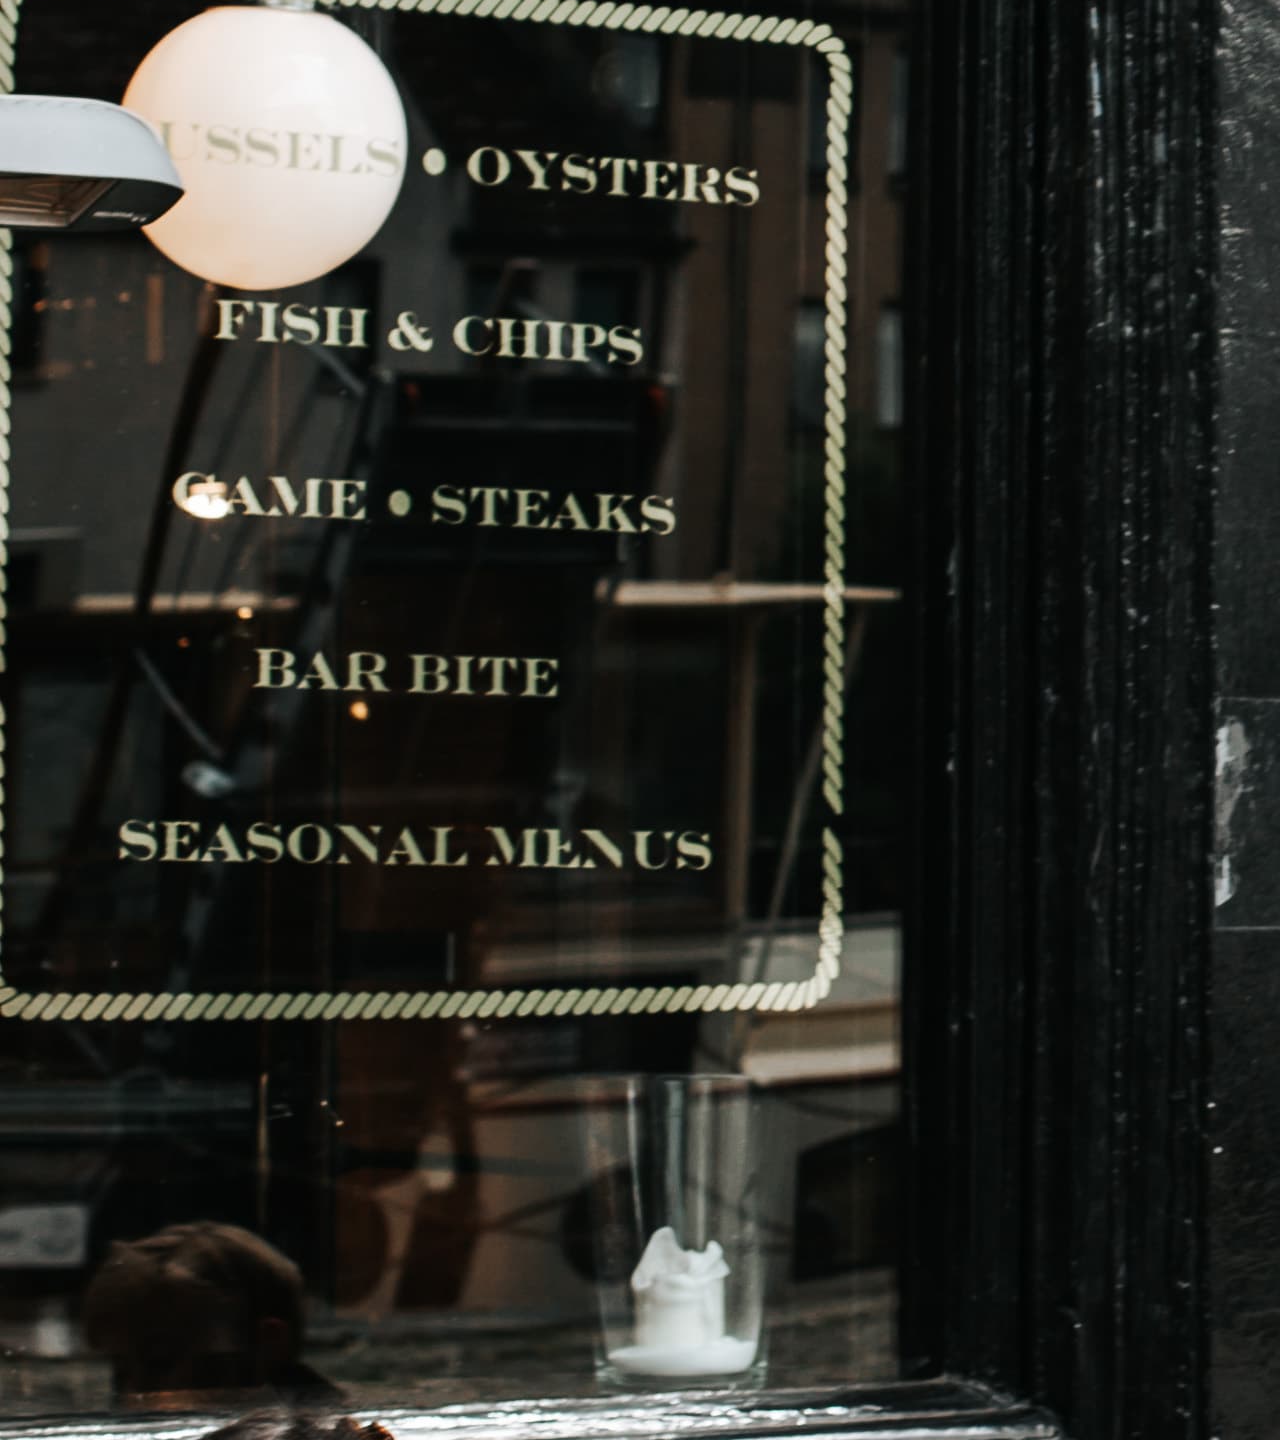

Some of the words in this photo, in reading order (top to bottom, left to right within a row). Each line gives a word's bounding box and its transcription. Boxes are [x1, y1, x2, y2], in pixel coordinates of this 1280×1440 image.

[154, 118, 402, 179] USSELS
[465, 144, 762, 209] OYSTERS
[212, 297, 370, 350] FISH
[387, 309, 435, 354] &
[451, 315, 646, 367] CHIPS
[430, 484, 679, 538] STEAKS
[252, 647, 391, 693] BAR
[406, 652, 560, 699] BITE
[117, 818, 470, 868] SEASONAL
[484, 824, 713, 872] MENUS
